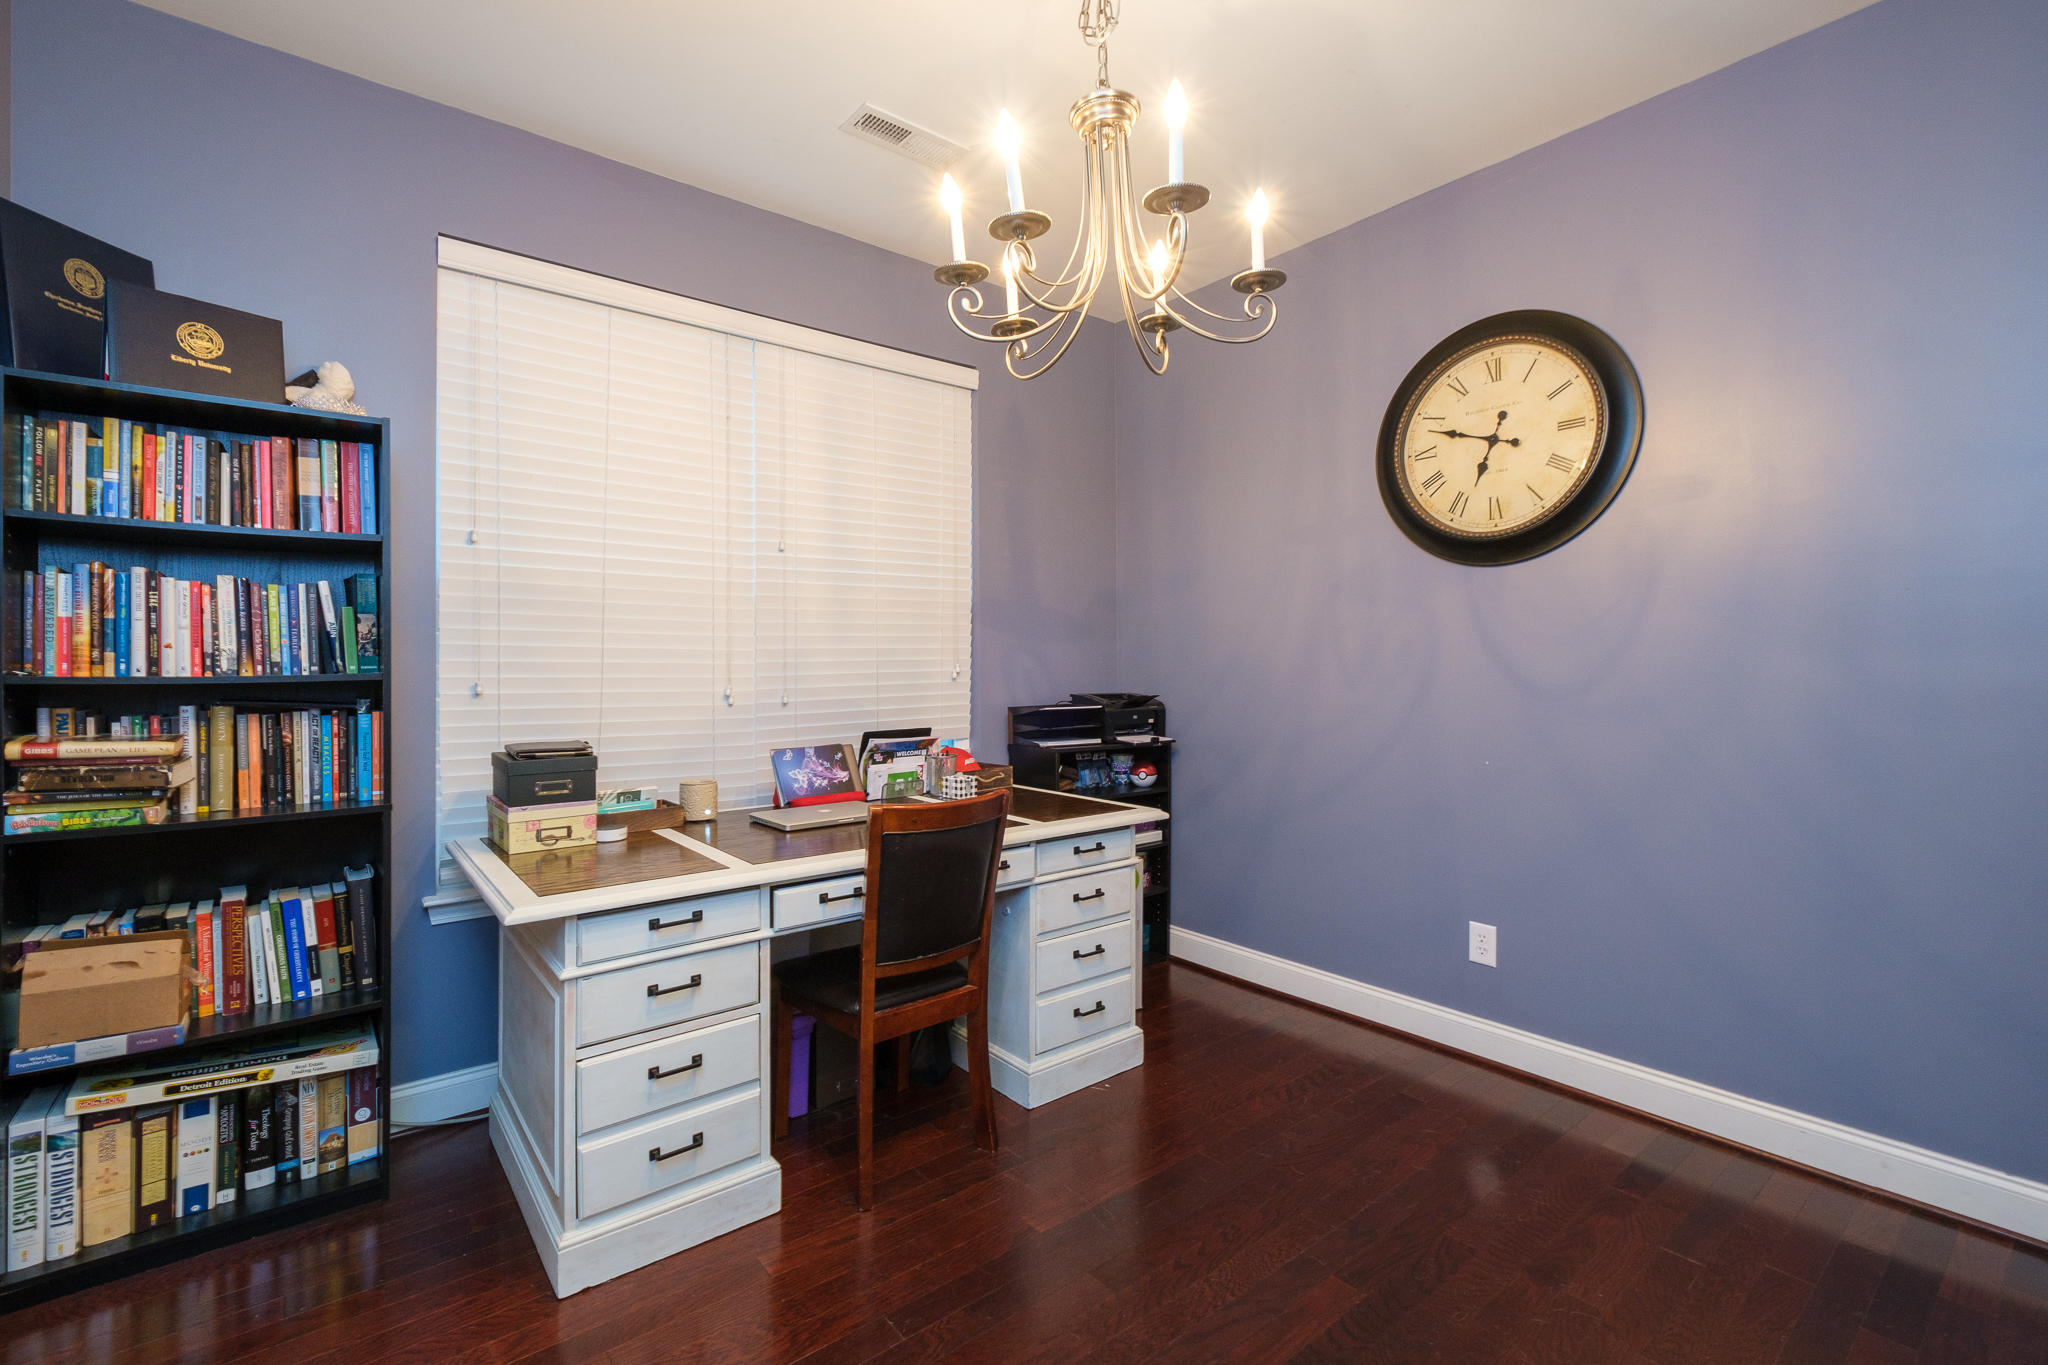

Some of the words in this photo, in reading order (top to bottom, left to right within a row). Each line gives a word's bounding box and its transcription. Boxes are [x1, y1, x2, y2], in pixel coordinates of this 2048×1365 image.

[197, 359, 232, 374] University
[35, 427, 43, 455] FOLLOW
[34, 479, 43, 502] PLATT
[45, 571, 55, 644] UNANSWERED
[218, 711, 227, 742] HEAVEN
[24, 747, 55, 755] GIBBS
[231, 905, 245, 976] PERSPECTIVES
[180, 1081, 213, 1092] Detroit
[214, 1075, 248, 1087] Edition
[302, 1082, 315, 1094] NIV
[219, 1109, 229, 1144] APOLOGETICS
[249, 1119, 258, 1129] for
[260, 1106, 271, 1140] Theology
[248, 1130, 259, 1151] Today
[12, 1153, 38, 1234] STRONGEST
[50, 1150, 74, 1228] STRONGEST
